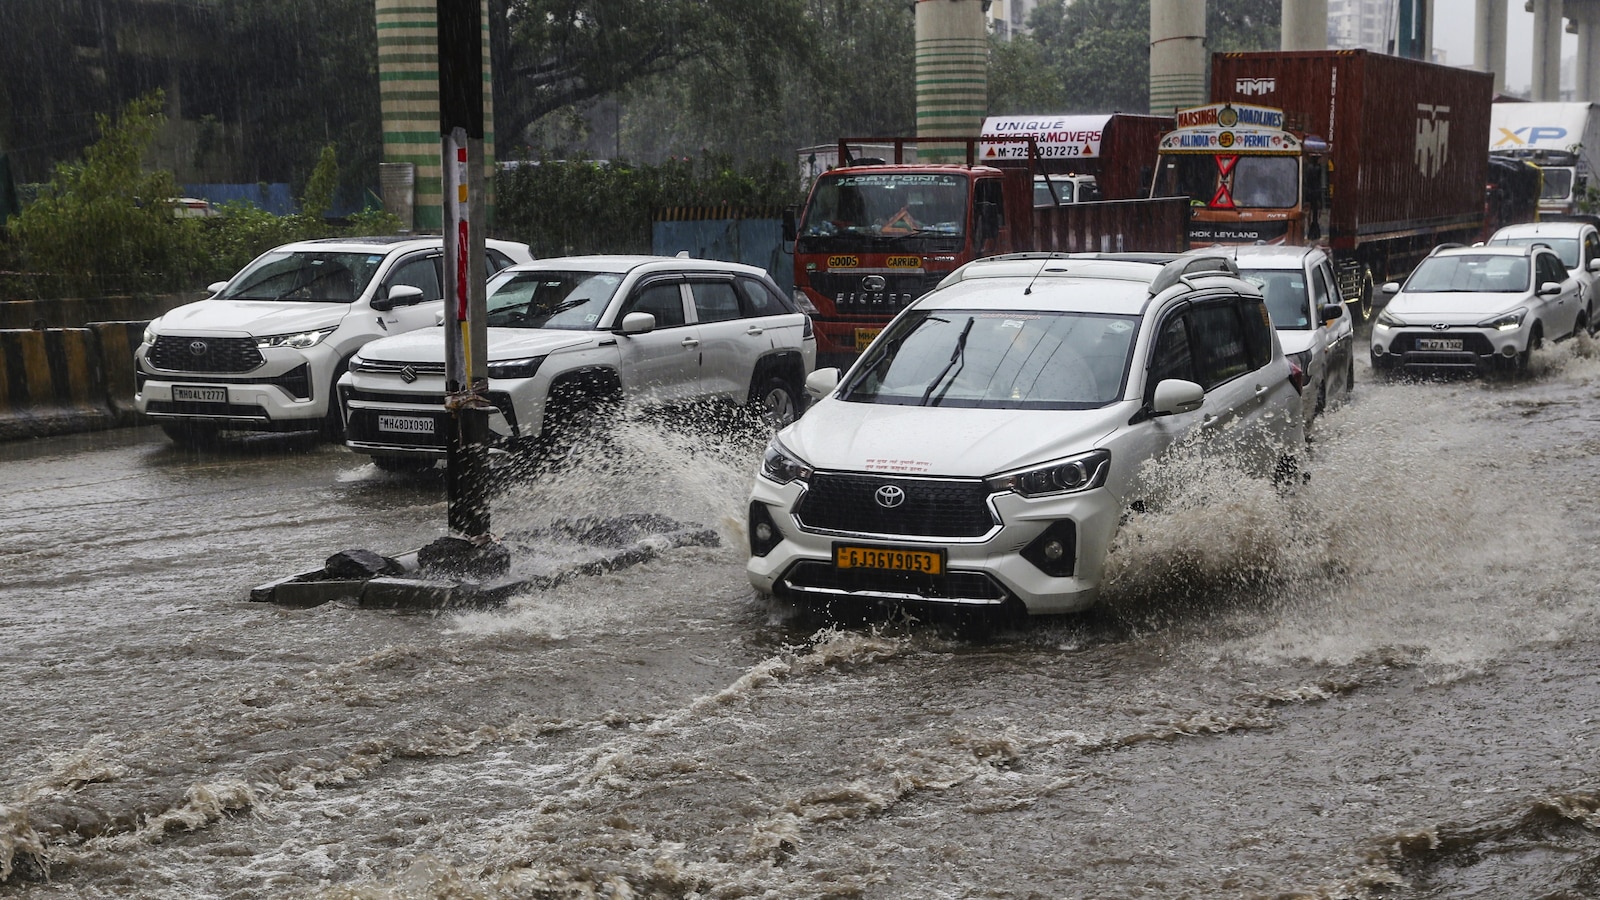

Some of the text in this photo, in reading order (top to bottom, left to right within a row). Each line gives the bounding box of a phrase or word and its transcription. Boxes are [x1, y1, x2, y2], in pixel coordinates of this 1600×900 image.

[1236, 78, 1275, 96] HMM
[1238, 108, 1282, 128] ROADLINES
[995, 121, 1065, 131] UNIQUE
[1244, 135, 1271, 147] PERMIT
[1414, 103, 1450, 179] HMM
[1494, 126, 1568, 146] XP
[998, 145, 1079, 157] M-725087273
[1214, 231, 1259, 239] LEYLAND
[829, 256, 858, 267] GOODS
[888, 257, 919, 267] CARRIER
[836, 293, 912, 305] EICHER
[179, 389, 225, 400] MH04LY2777
[384, 418, 433, 431] MH48DX0902
[850, 550, 932, 571] GJ36V9053
